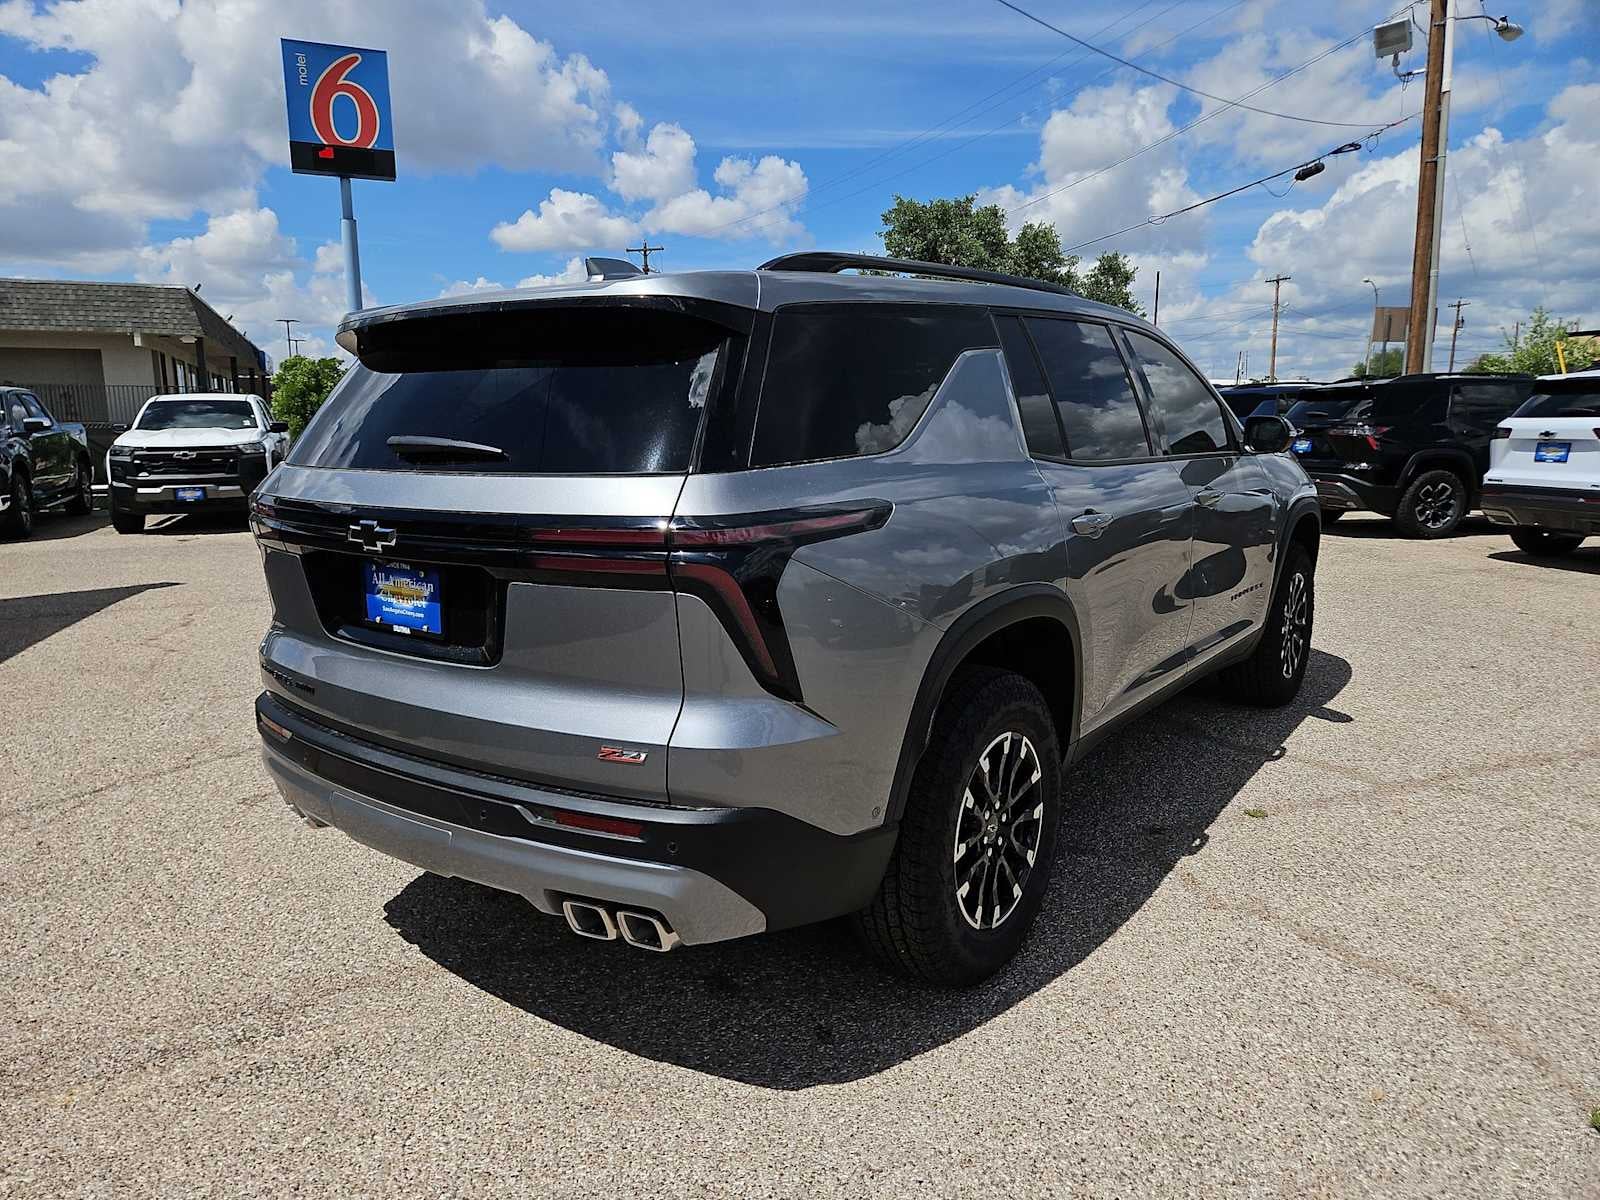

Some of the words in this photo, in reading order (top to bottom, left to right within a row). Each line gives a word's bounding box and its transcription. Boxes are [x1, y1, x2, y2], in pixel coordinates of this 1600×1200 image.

[295, 52, 309, 86] motel
[309, 52, 380, 149] 6
[371, 571, 385, 585] All
[387, 574, 434, 593] American
